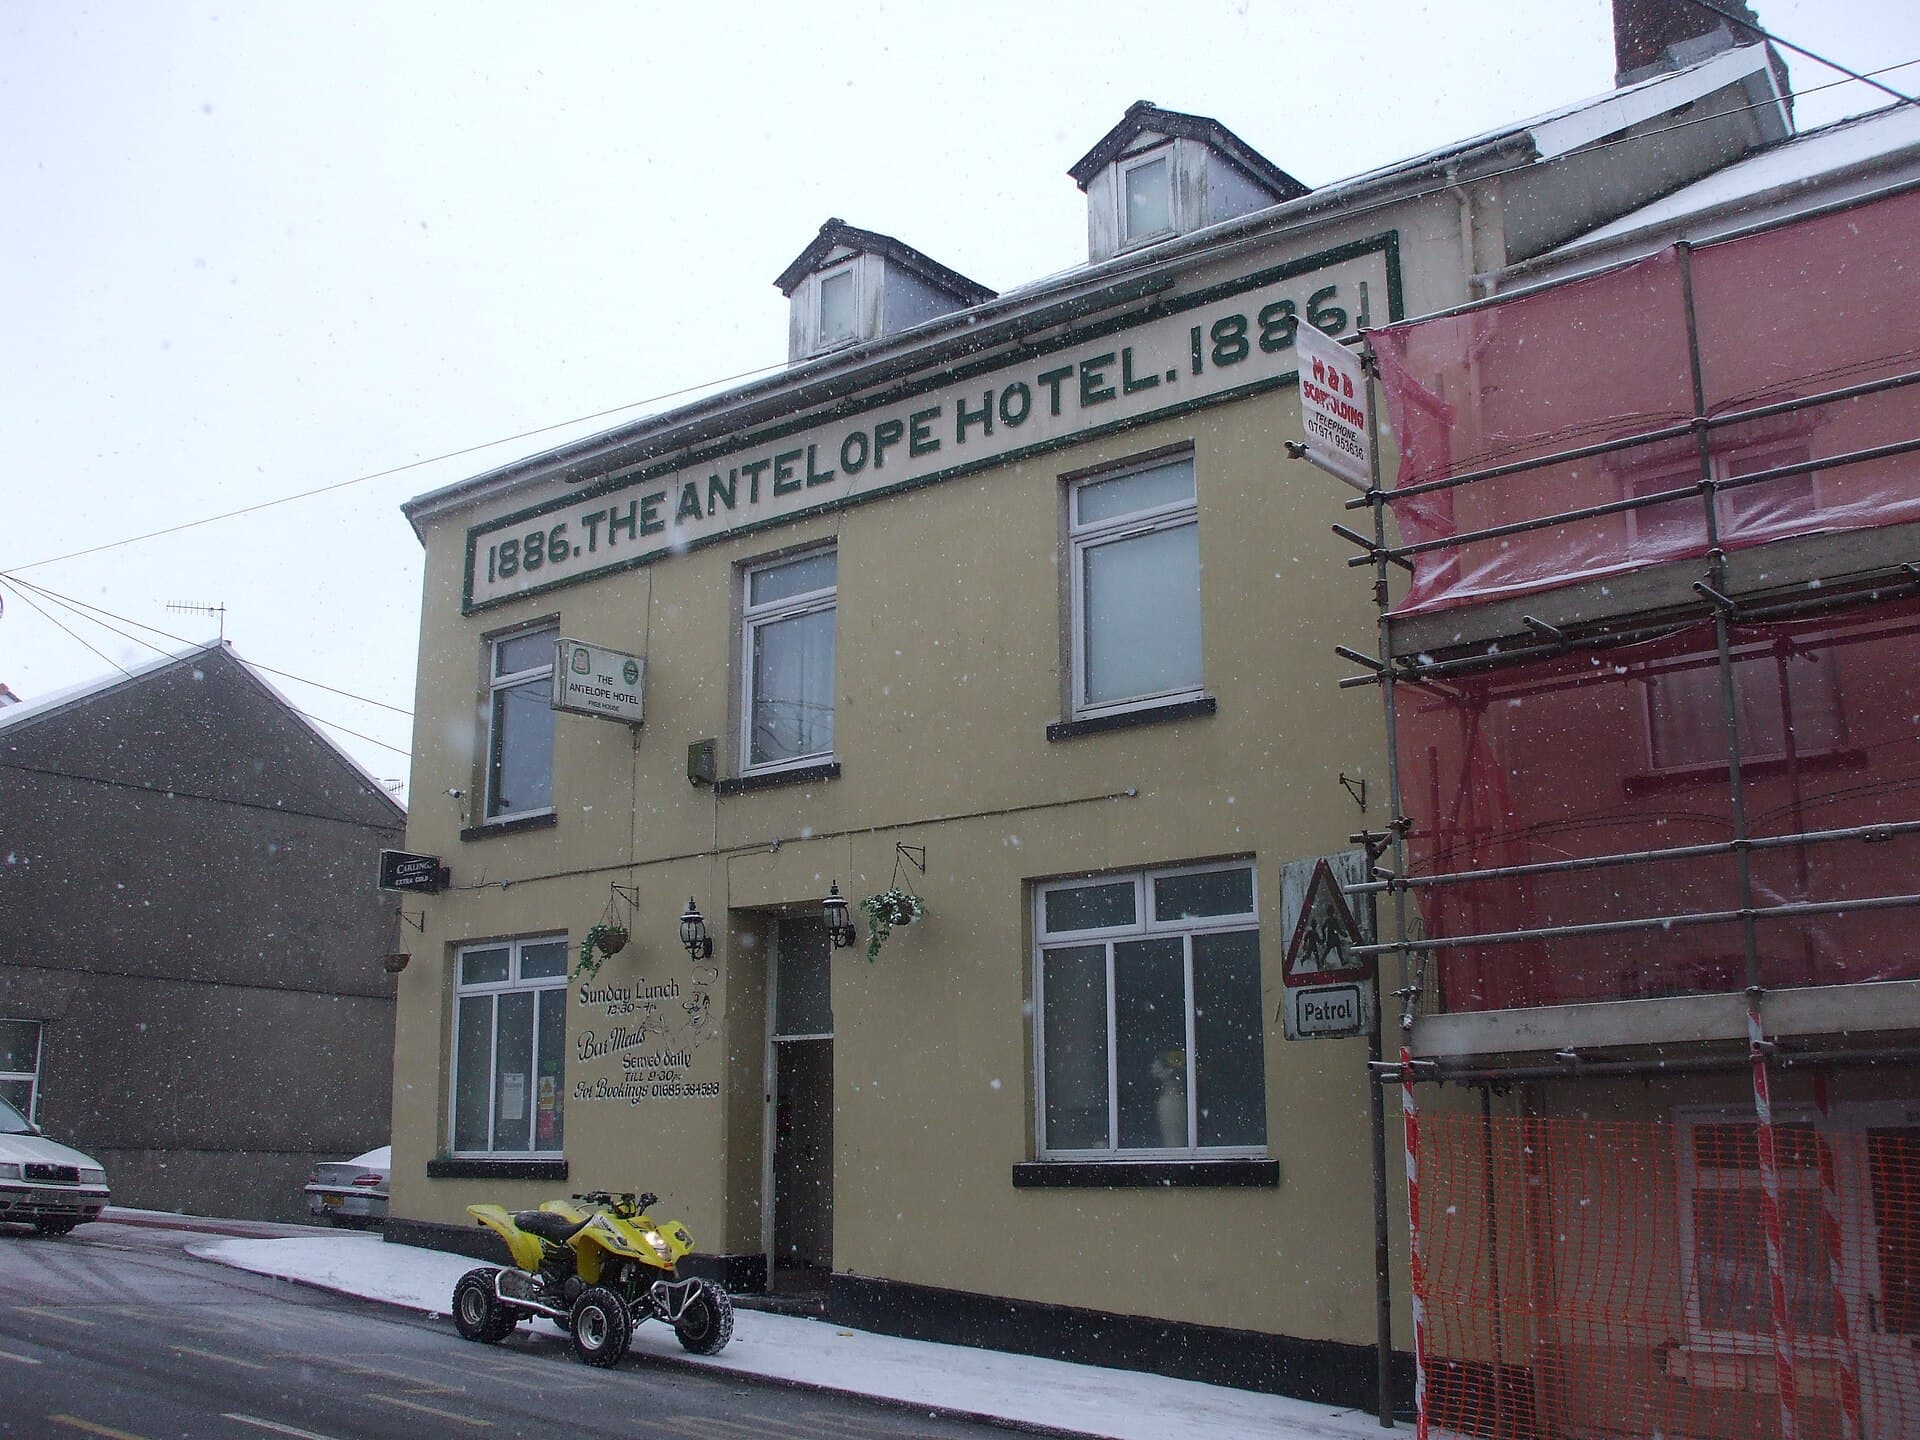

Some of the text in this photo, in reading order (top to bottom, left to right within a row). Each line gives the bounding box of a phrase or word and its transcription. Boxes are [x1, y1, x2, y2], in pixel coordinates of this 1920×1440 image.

[1311, 355, 1325, 384] M
[1341, 372, 1354, 398] B
[1308, 419, 1333, 442] 07971
[488, 523, 581, 584] 1886.
[581, 491, 666, 553] THE
[674, 406, 942, 526] ANTELOPE
[956, 347, 1176, 444] HOTEL.
[597, 674, 613, 686] THE
[569, 683, 639, 705] ANTELOPE HOTEL
[396, 861, 431, 874] CARLING
[579, 978, 680, 1005] Sunday Lunch
[1304, 1000, 1352, 1022] Patrol
[610, 1022, 646, 1051] Meals
[622, 1049, 691, 1068] Served daily
[595, 1077, 648, 1104] Bookings
